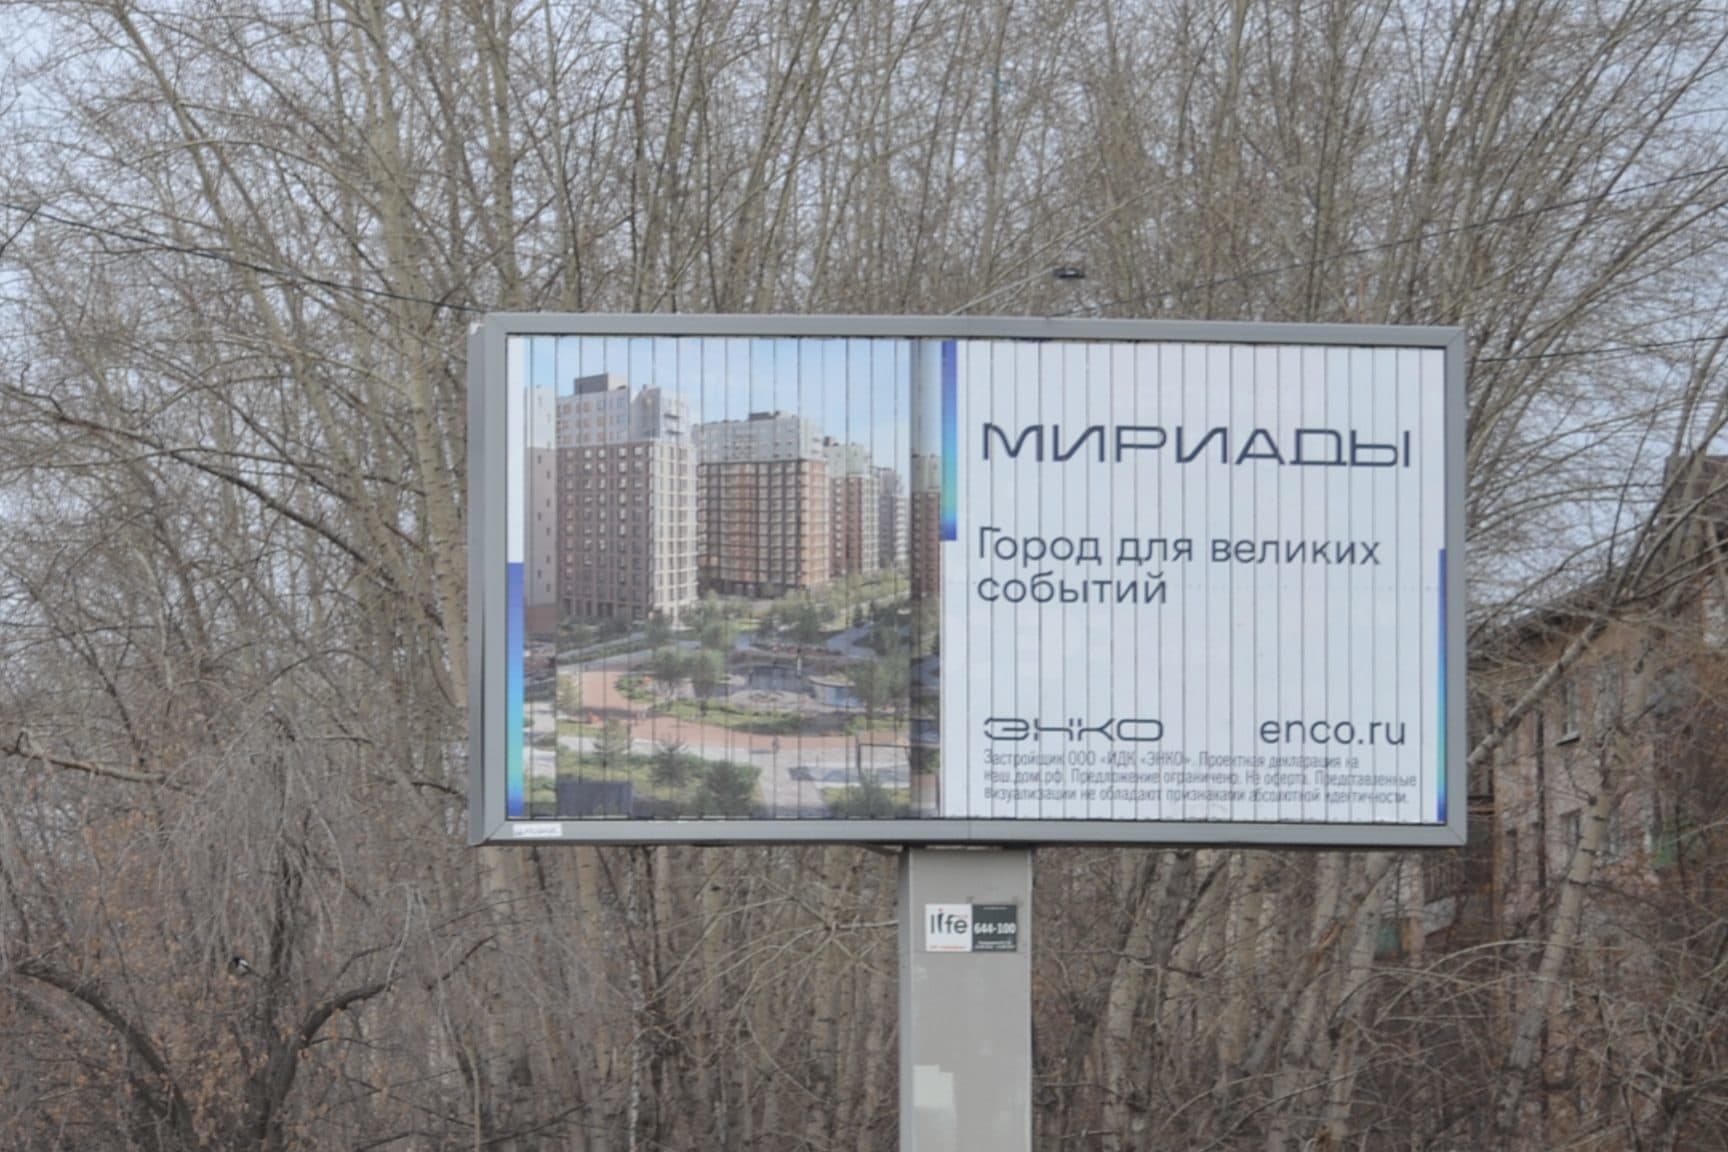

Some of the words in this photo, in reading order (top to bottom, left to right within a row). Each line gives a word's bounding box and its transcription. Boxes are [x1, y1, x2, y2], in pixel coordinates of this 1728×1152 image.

[983, 423, 1410, 468] МИРИАДЫ
[979, 526, 1102, 568] Город
[1117, 538, 1192, 566] для
[1211, 539, 1381, 565] великих
[977, 570, 1166, 604] событий
[1260, 720, 1405, 745] enco.ru
[1068, 750, 1096, 766] ООО
[1199, 752, 1265, 768] Проектная
[1269, 754, 1341, 768] декларация
[1071, 768, 1160, 784] Предложение
